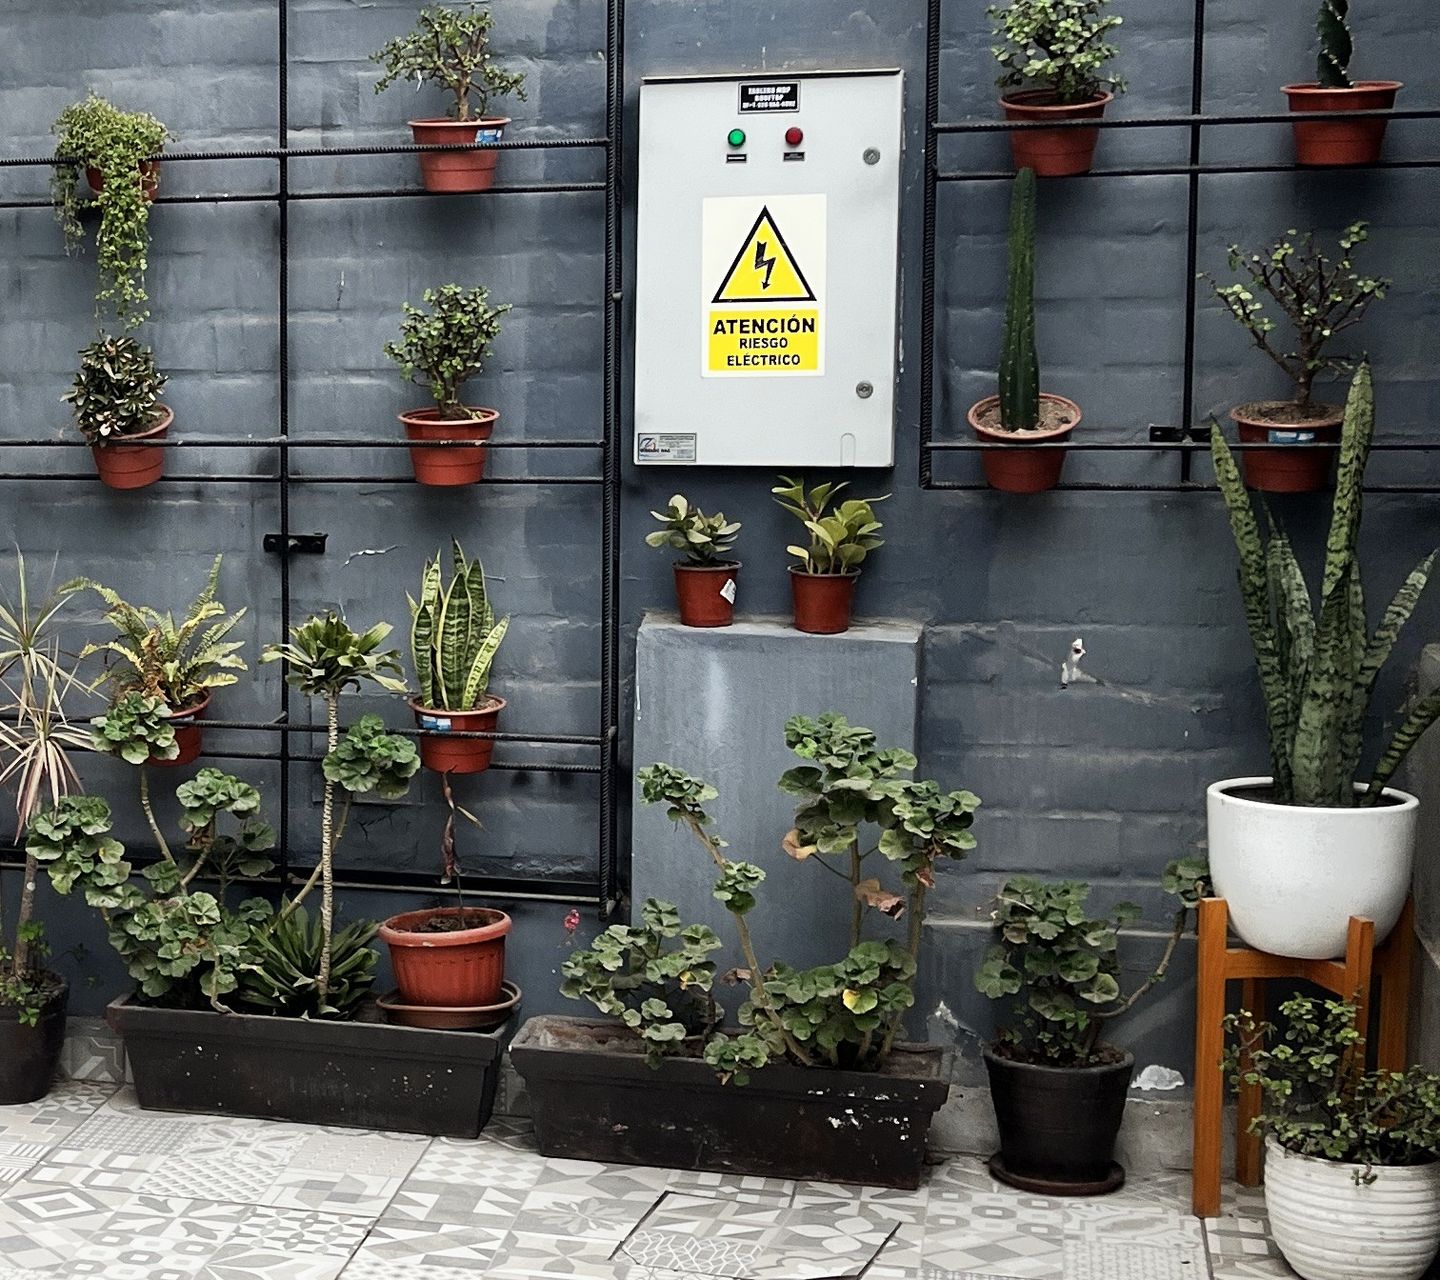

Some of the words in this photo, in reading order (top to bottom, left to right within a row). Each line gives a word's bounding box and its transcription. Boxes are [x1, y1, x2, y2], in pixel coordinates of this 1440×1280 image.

[713, 314, 815, 335] ATENCIÓN
[739, 337, 789, 349] RIESGO
[727, 353, 801, 366] ELÉCTRICO
